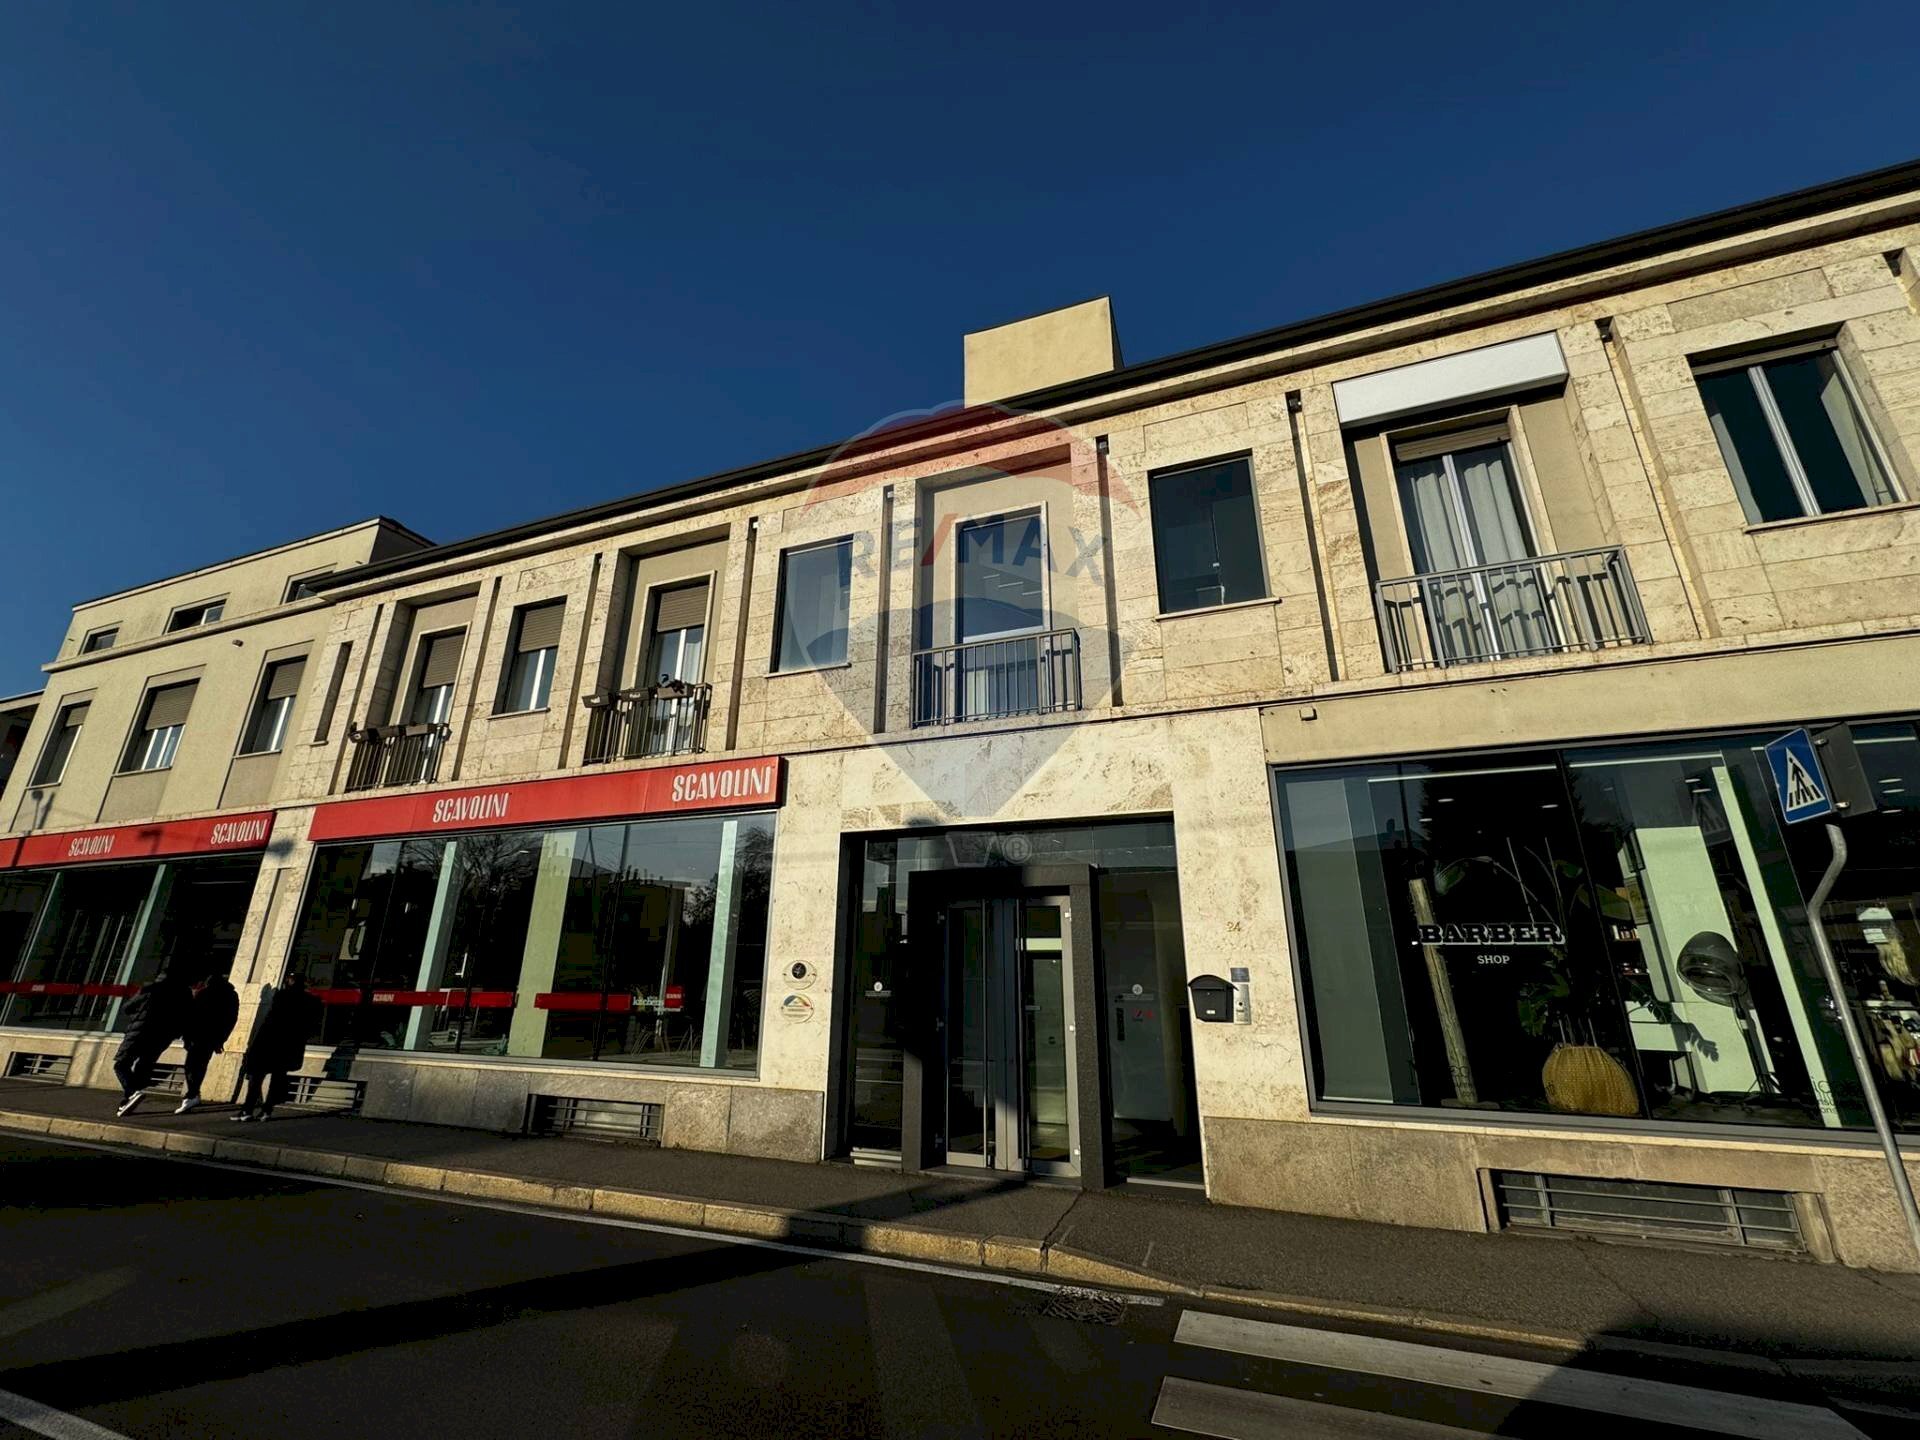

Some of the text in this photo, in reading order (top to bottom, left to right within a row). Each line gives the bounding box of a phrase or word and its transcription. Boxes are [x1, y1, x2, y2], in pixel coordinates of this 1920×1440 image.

[672, 765, 773, 803] SCAVOLINI
[432, 792, 510, 824] SCAVOLINI
[210, 819, 268, 845] SCAVOLINI
[67, 835, 116, 857] SCAVOLINI
[1226, 920, 1242, 933] 24
[1418, 922, 1566, 946] BARBER
[1476, 954, 1511, 965] SHOP
